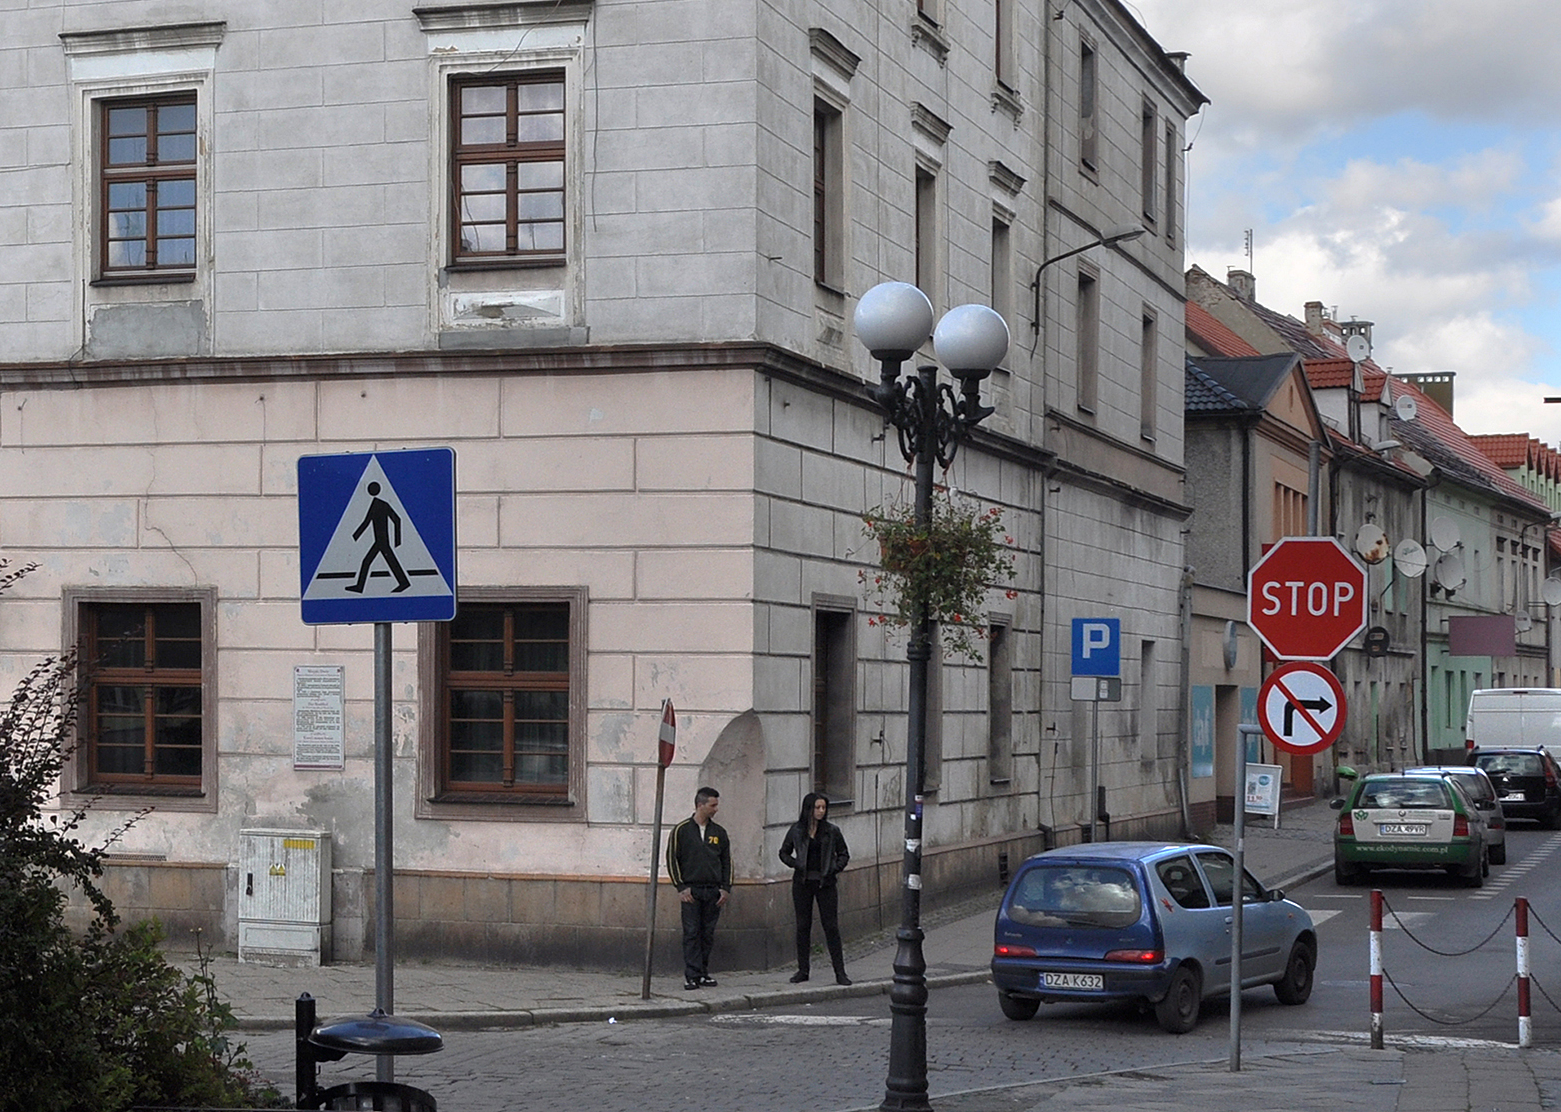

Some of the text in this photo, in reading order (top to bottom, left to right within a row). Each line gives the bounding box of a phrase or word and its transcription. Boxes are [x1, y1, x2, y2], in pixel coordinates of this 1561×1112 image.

[1261, 580, 1355, 617] STOP
[1082, 623, 1110, 659] P
[1385, 824, 1404, 833] DZA
[1045, 973, 1102, 988] DZA K632
